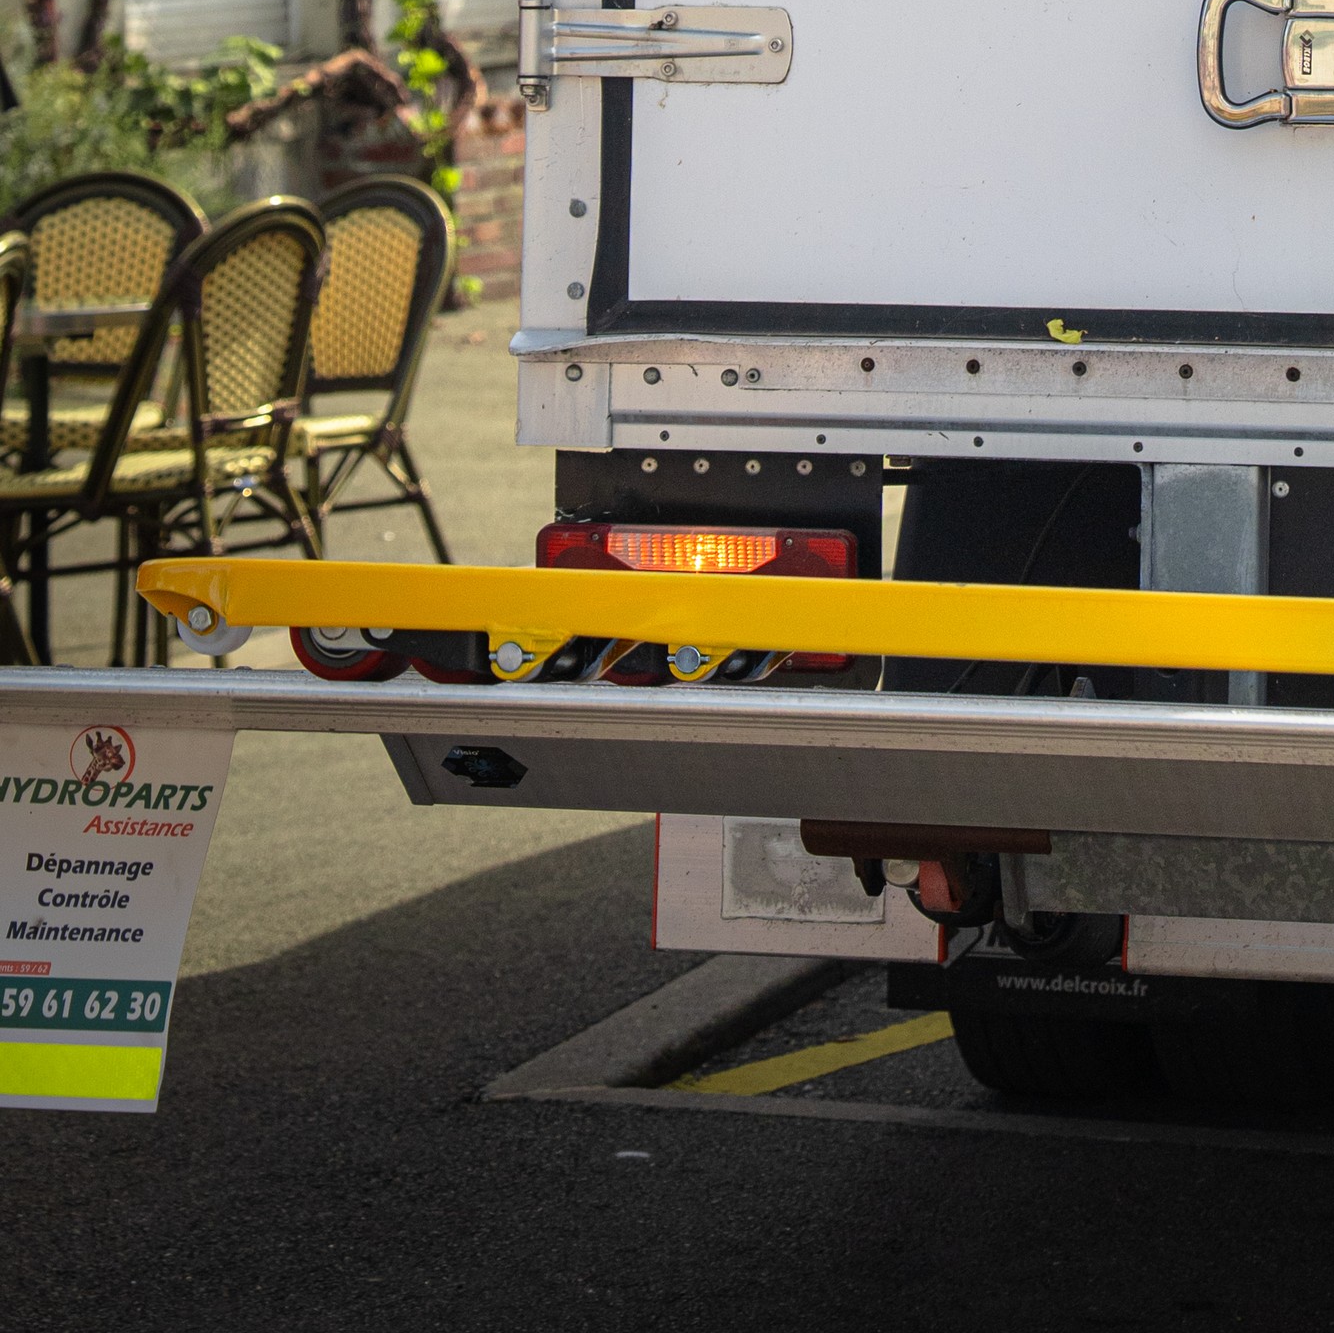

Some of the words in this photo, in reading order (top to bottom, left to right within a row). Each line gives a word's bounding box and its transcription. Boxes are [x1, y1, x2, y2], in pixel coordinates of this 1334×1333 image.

[83, 815, 194, 837] Assistance
[26, 852, 153, 881] Dépannage
[38, 888, 130, 909] Contrôle
[6, 920, 144, 943] Maintenance
[20, 964, 31, 973] 59
[38, 964, 49, 974] 62
[997, 974, 1148, 997] www.delcroix.fr
[1, 987, 34, 1017] 59
[42, 988, 73, 1019] 61
[84, 989, 119, 1020] 62
[126, 991, 161, 1021] 30
